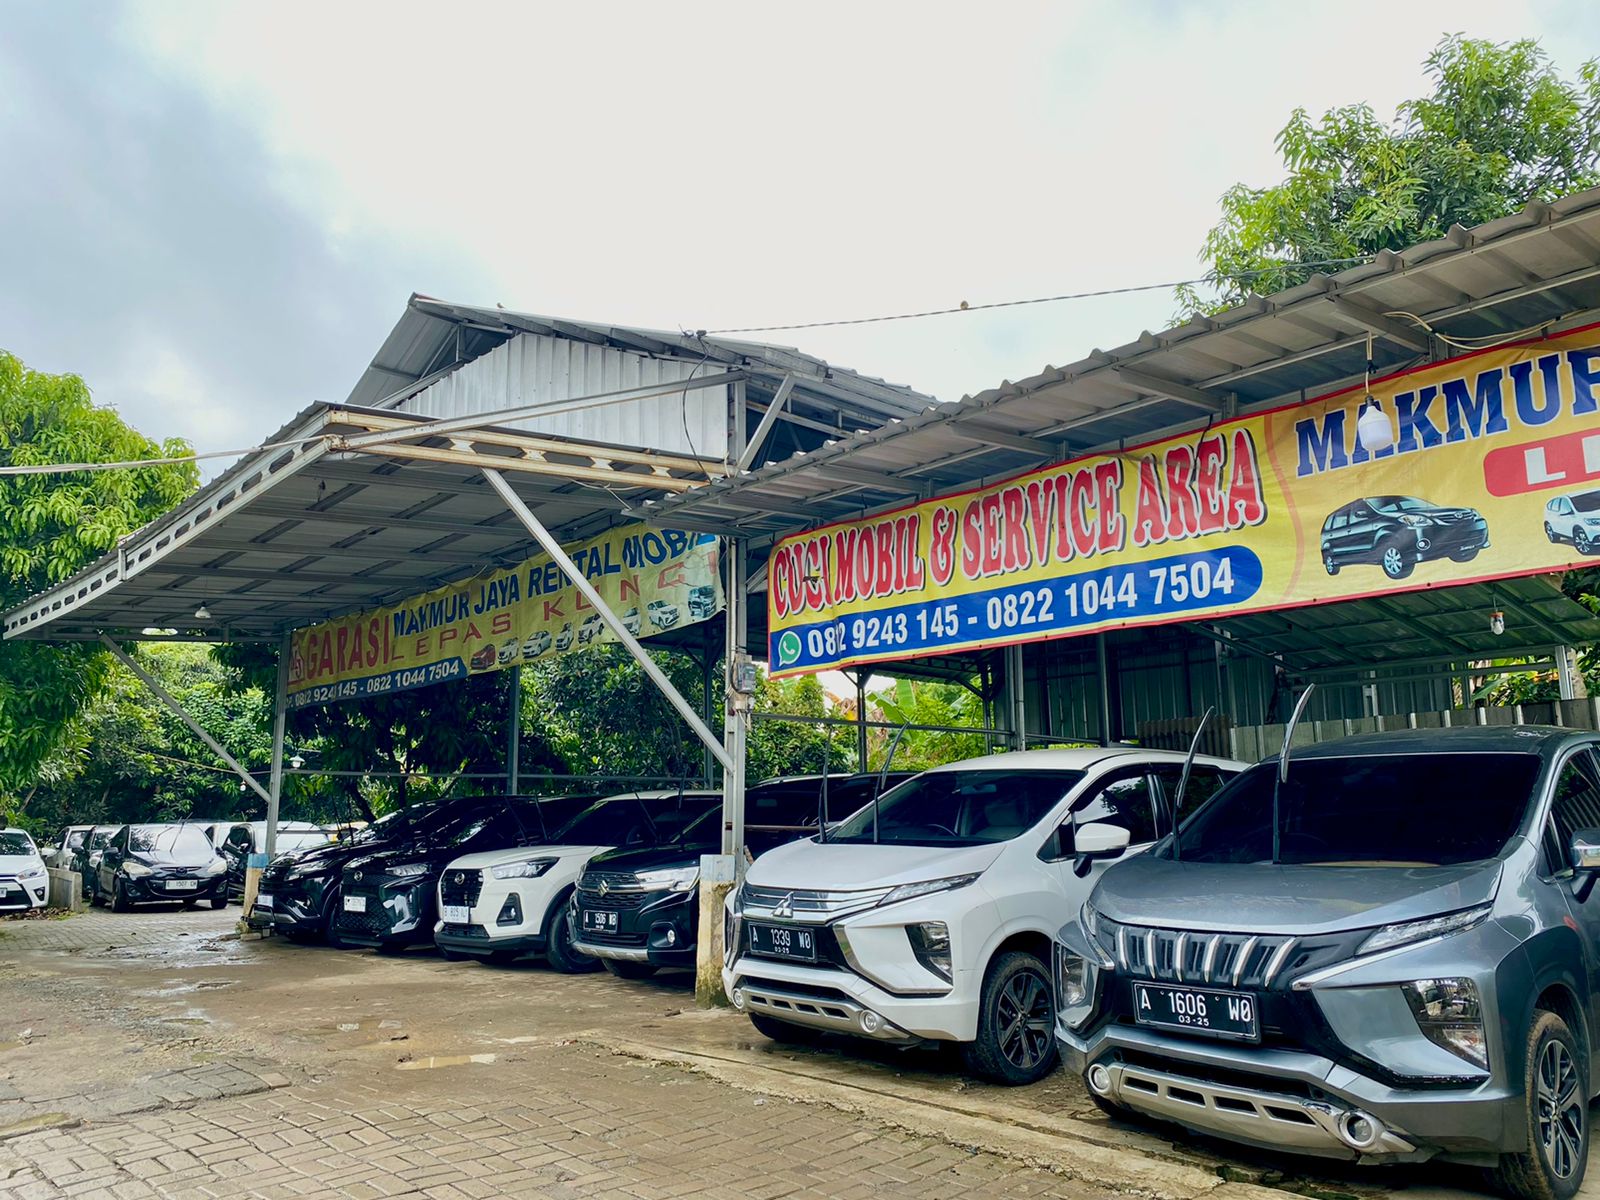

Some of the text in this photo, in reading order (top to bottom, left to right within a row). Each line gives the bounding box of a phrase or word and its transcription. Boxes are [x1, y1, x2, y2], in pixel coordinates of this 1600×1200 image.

[772, 427, 1268, 619] CUCI MOBIL & SERVICE AREA
[852, 612, 908, 649] 9243
[917, 604, 959, 640] 145
[987, 590, 1054, 630] 0822
[1064, 575, 1138, 616] 1044
[1149, 556, 1235, 604] 7504
[307, 615, 389, 680] GARASI
[393, 591, 470, 638] MAKMUR
[474, 573, 520, 614] JAYA
[391, 612, 511, 661] LEPAS
[338, 681, 358, 698] 145
[366, 677, 392, 693] 0822
[394, 672, 426, 688] 1044
[429, 660, 460, 680] 7504
[753, 926, 758, 942] A
[771, 929, 791, 946] 1339
[1140, 988, 1152, 1010] A
[1167, 991, 1207, 1017] 1606
[1178, 1014, 1210, 1027] 03-25
